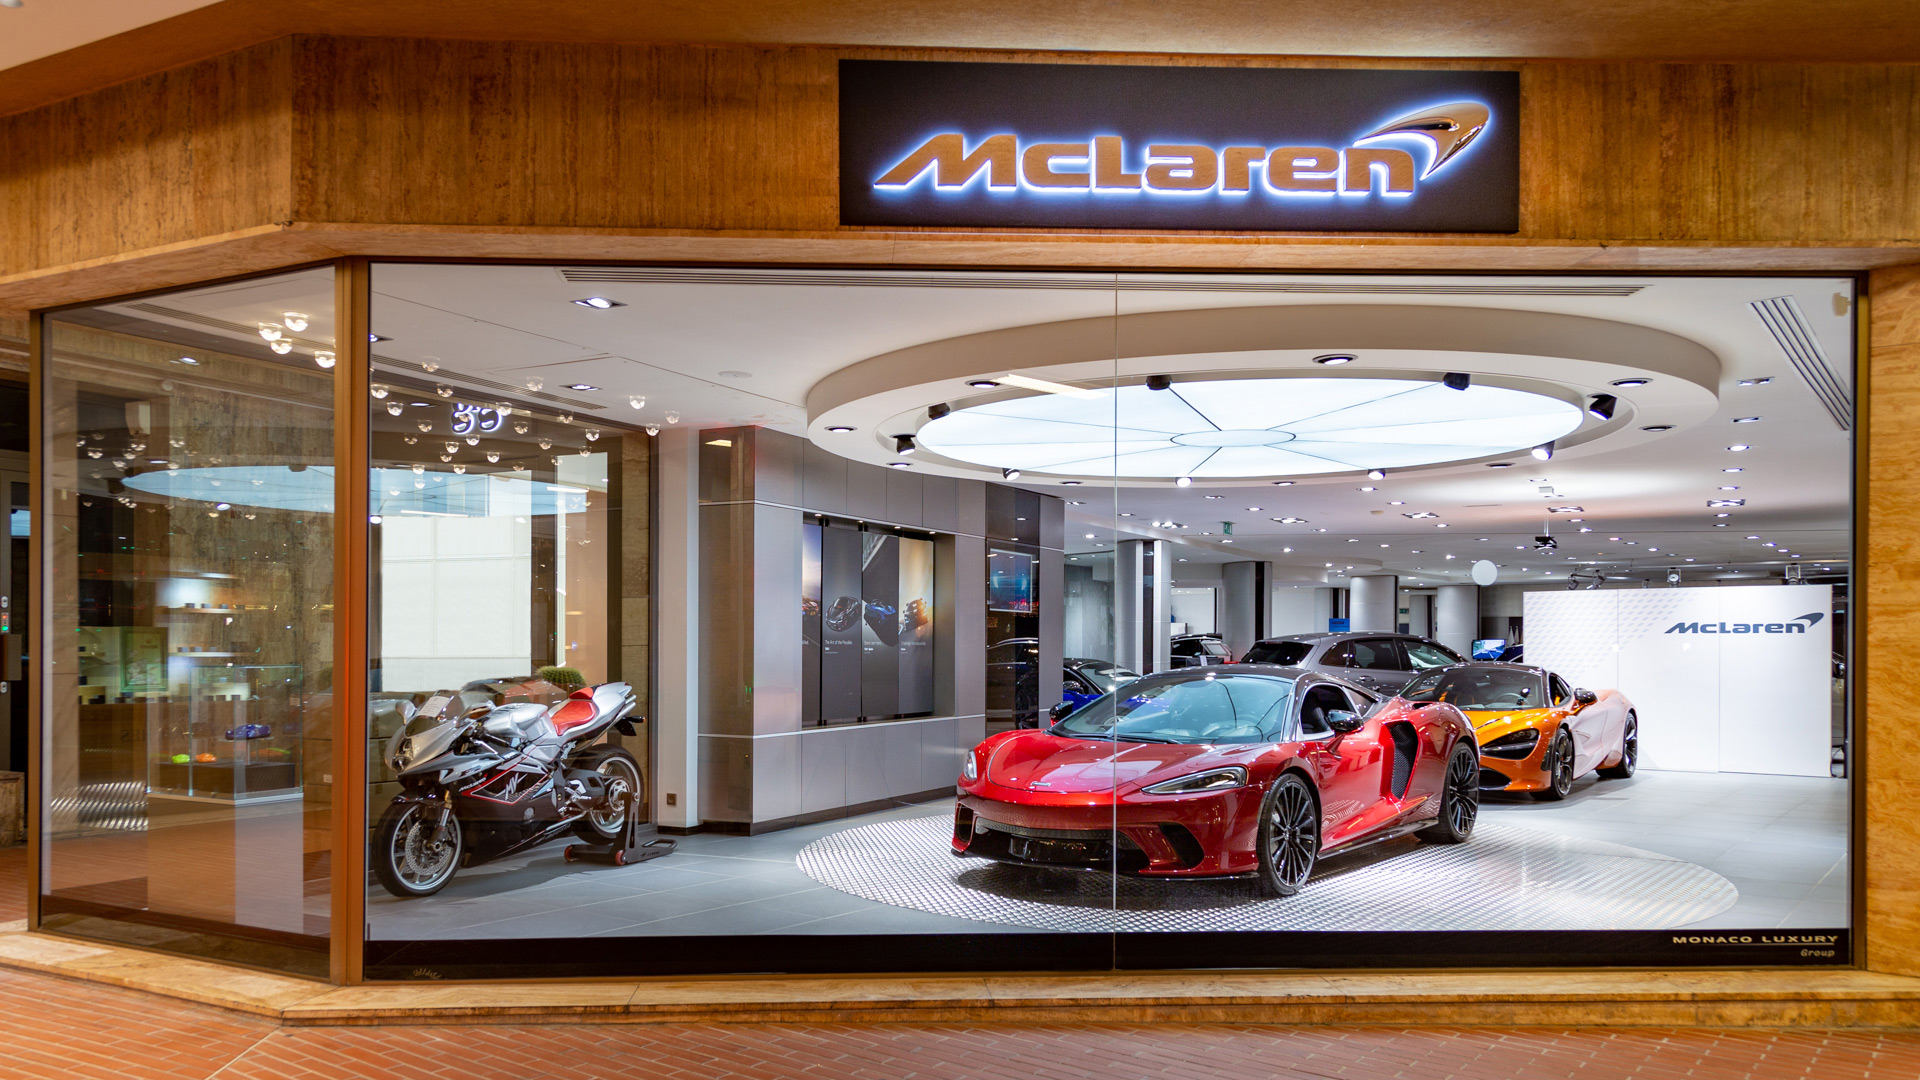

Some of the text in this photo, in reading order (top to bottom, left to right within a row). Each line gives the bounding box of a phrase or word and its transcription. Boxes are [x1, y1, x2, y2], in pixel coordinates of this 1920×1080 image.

[873, 133, 1415, 196] McLaren
[1664, 621, 1806, 634] McLaren
[1672, 935, 1839, 944] MONACO LUXURY
[1800, 948, 1835, 957] Group
